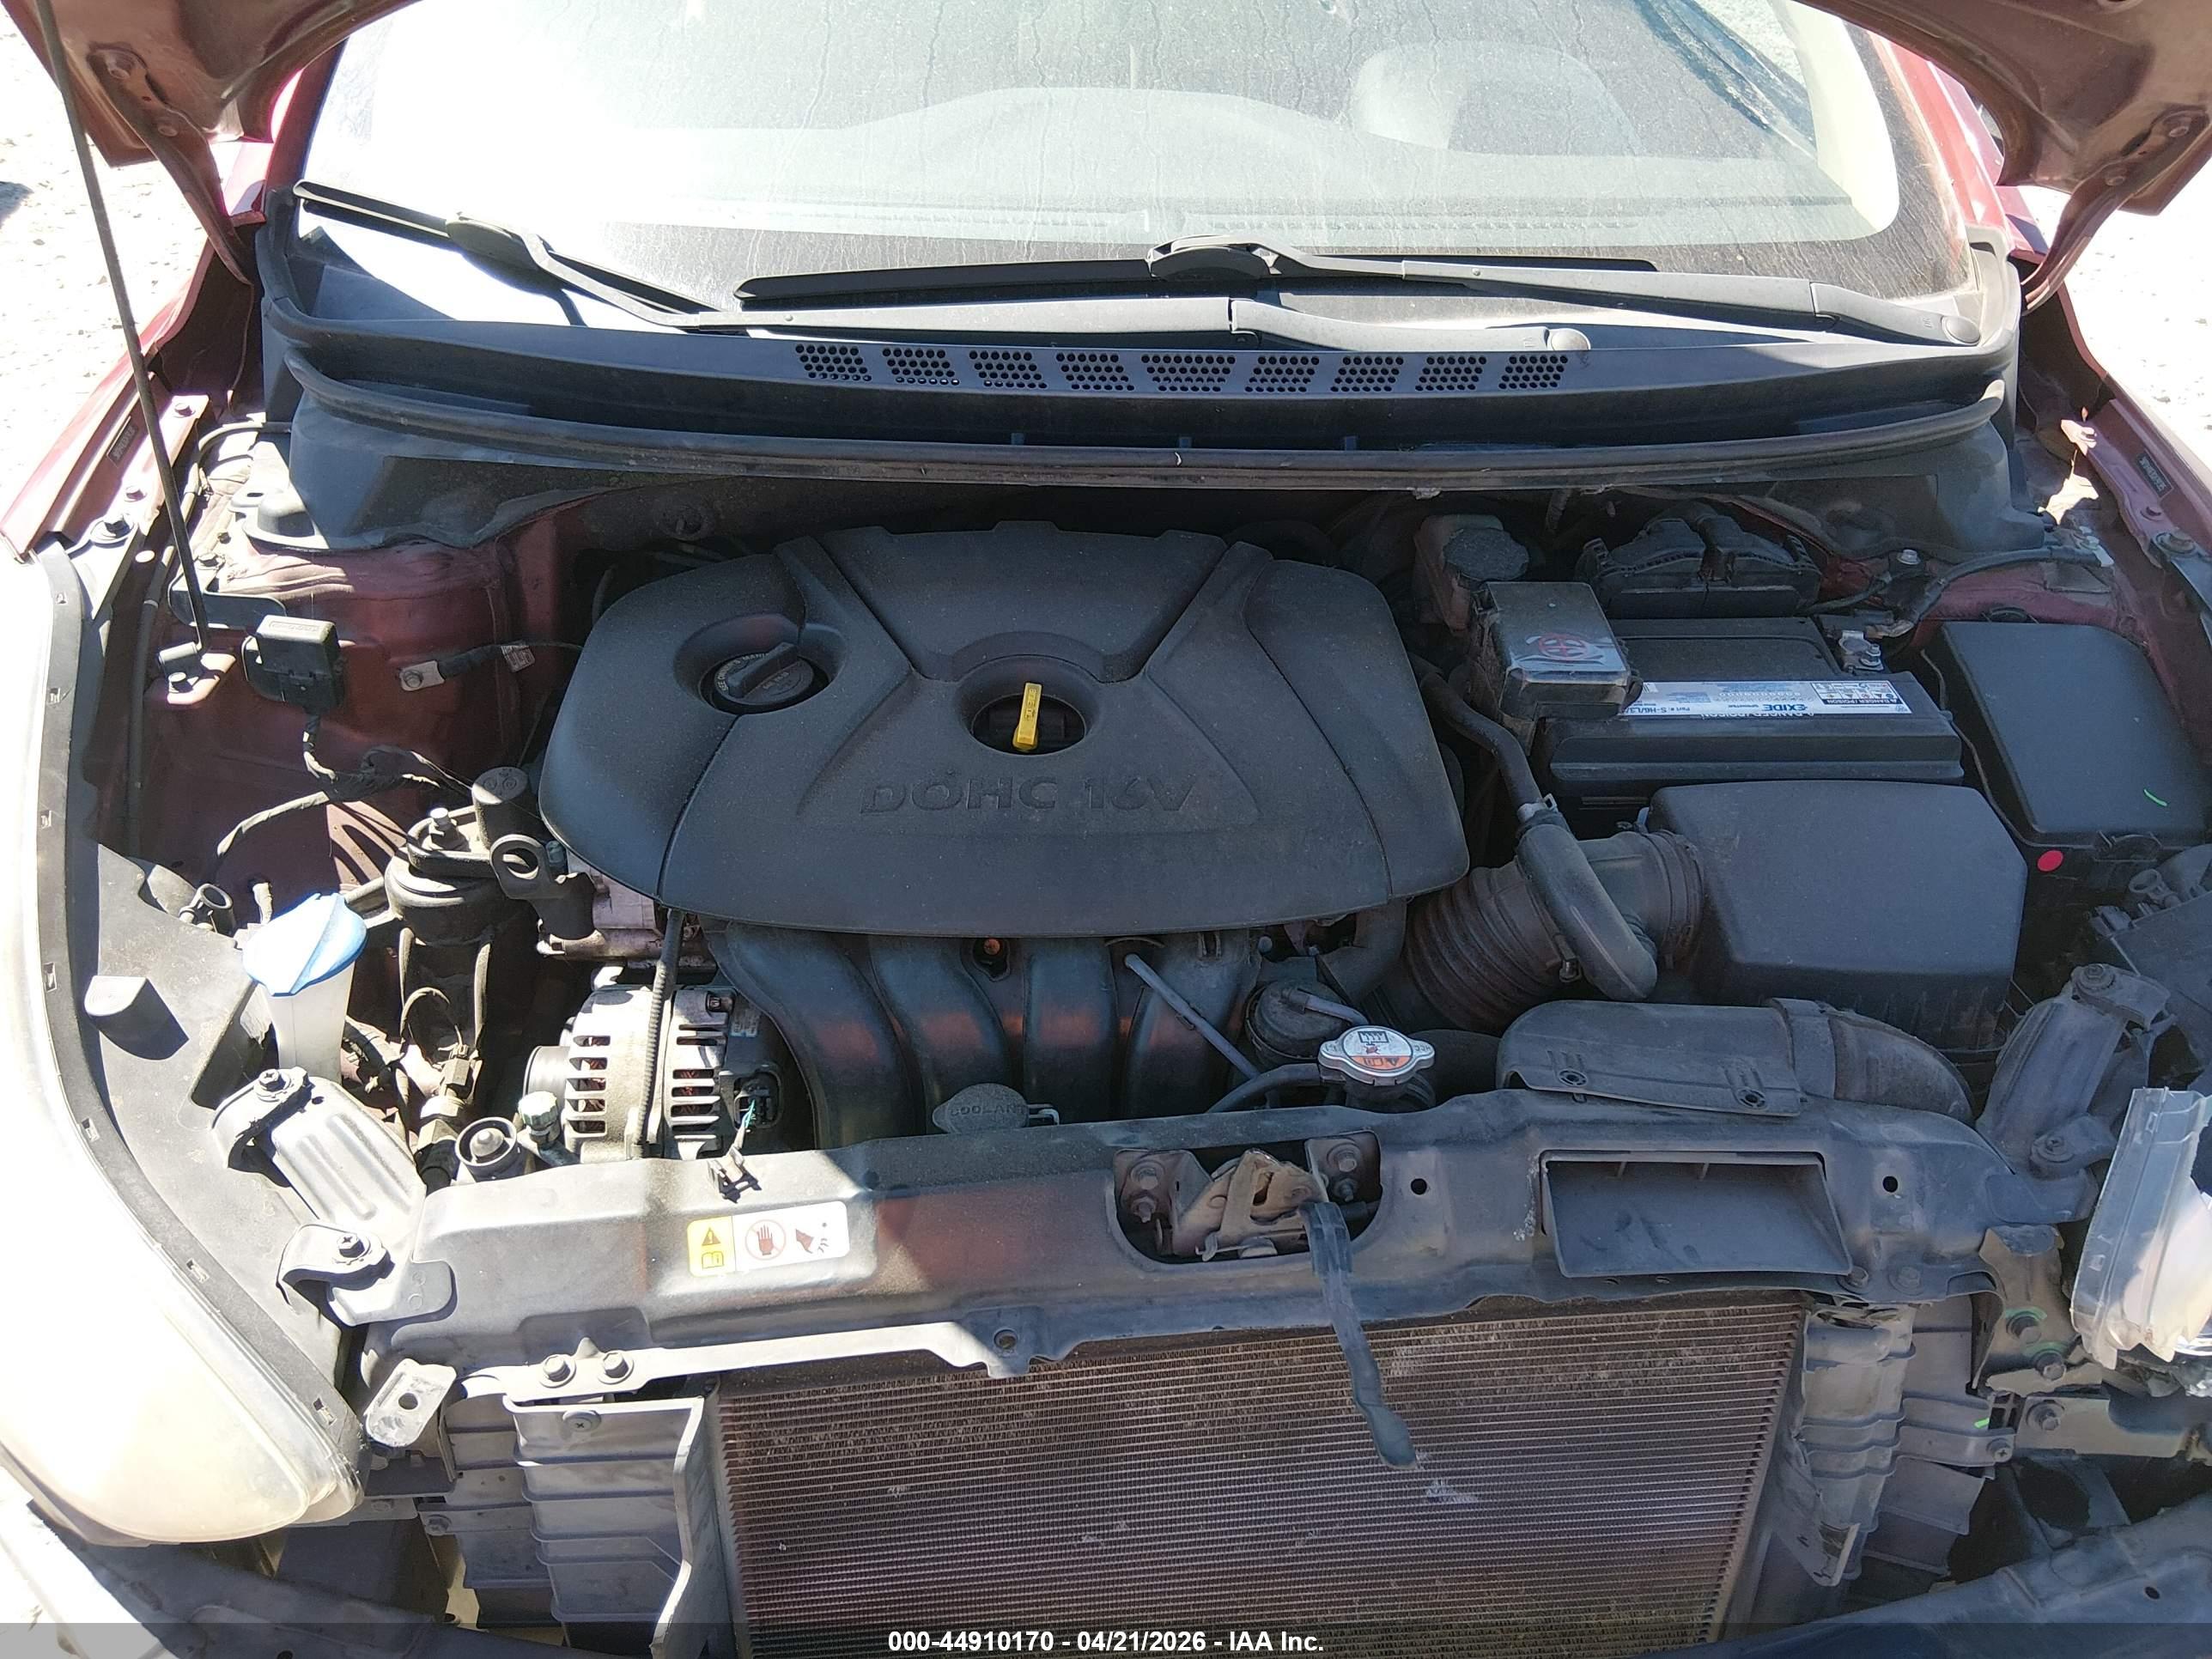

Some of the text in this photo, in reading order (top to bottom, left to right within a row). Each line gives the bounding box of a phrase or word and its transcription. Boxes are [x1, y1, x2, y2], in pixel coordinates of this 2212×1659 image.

[1761, 703, 1808, 712] EXIDE
[860, 775, 1199, 814] DOHC 16V
[950, 1103, 1027, 1117] COOLANT
